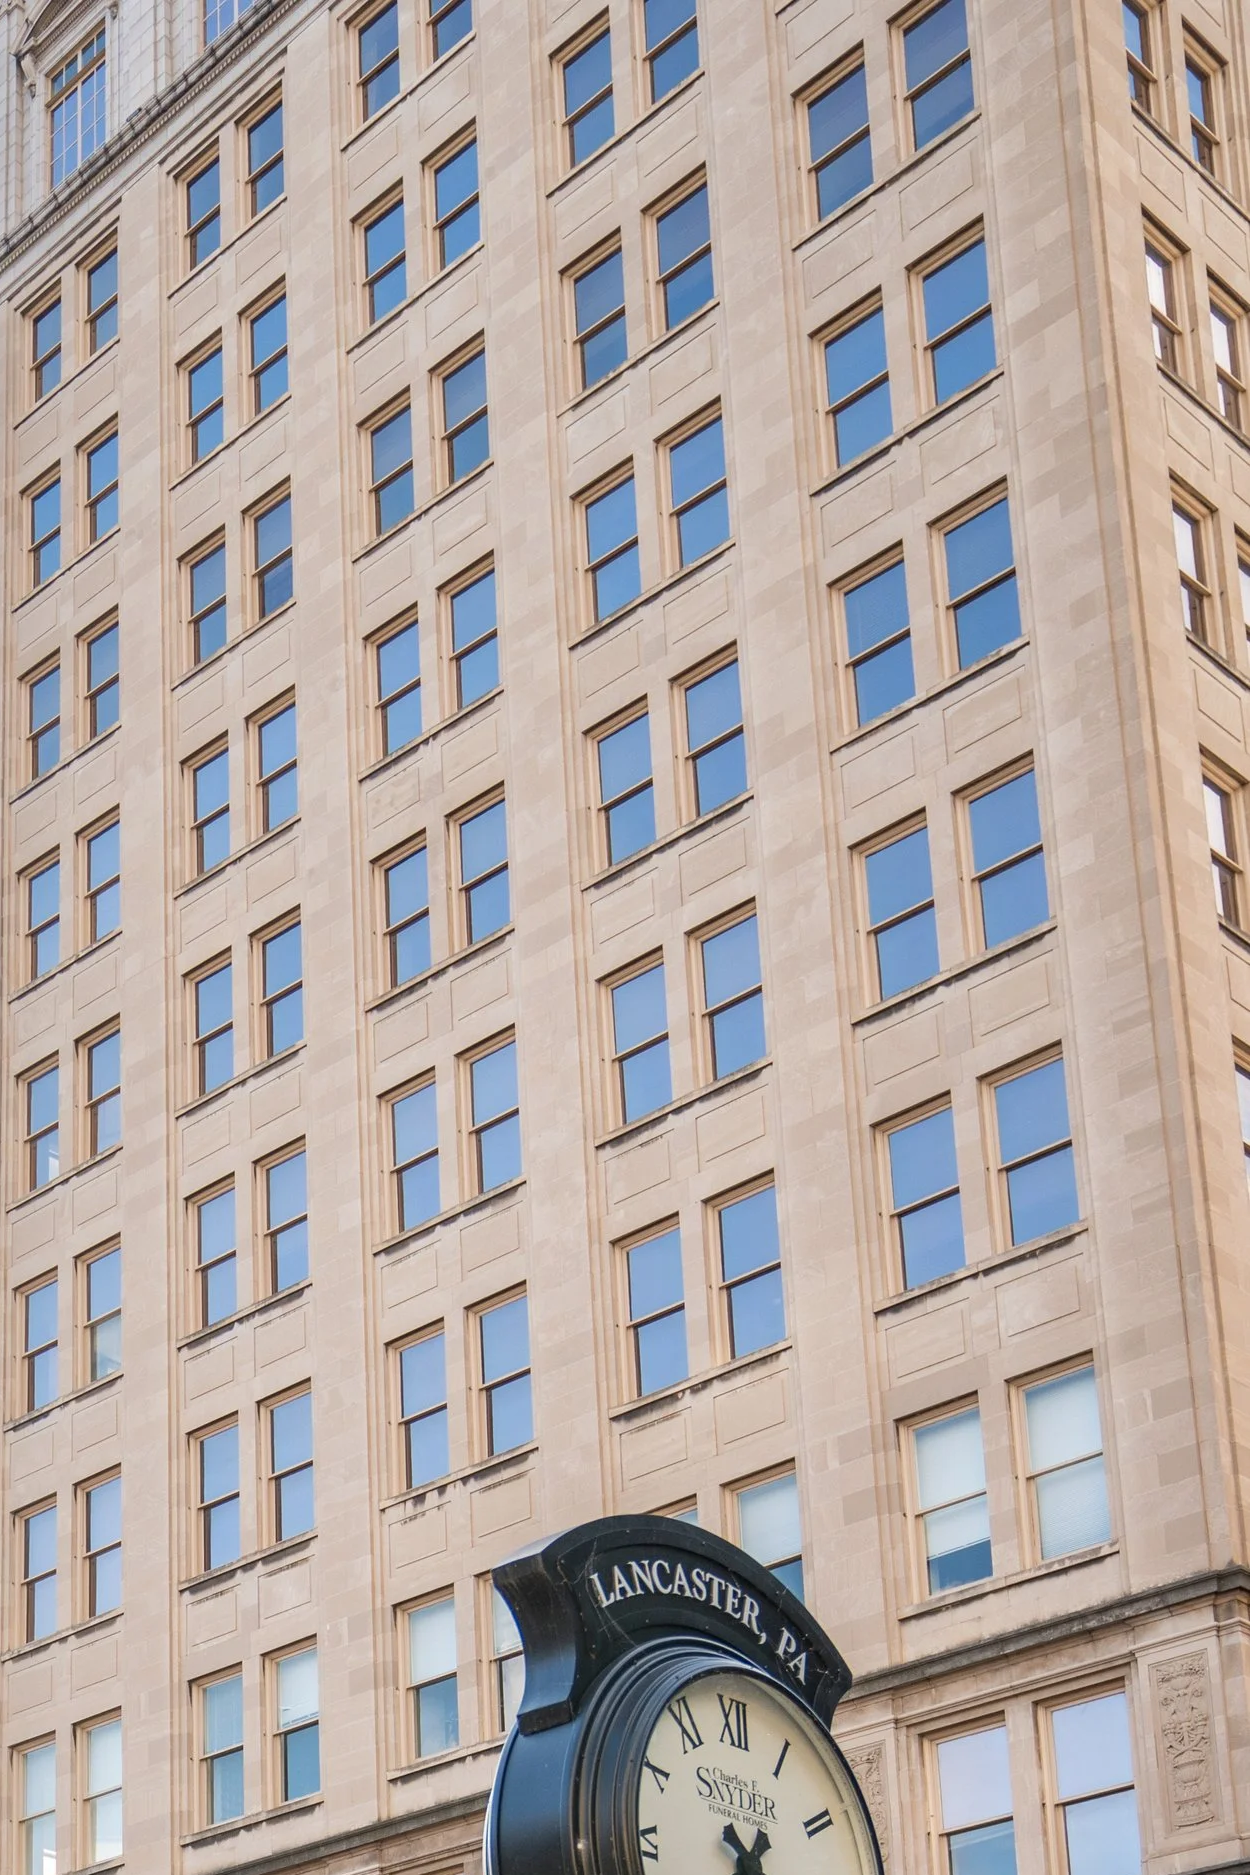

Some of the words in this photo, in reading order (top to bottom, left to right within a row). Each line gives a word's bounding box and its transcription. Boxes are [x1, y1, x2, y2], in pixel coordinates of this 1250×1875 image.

[589, 1560, 767, 1645] LANCASTER,
[775, 1627, 809, 1686] PA
[696, 1766, 777, 1820] SNYDER
[712, 1767, 748, 1789] Charles
[751, 1780, 760, 1793] F.
[708, 1804, 741, 1822] FUNERAL
[742, 1815, 768, 1831] HOMES
